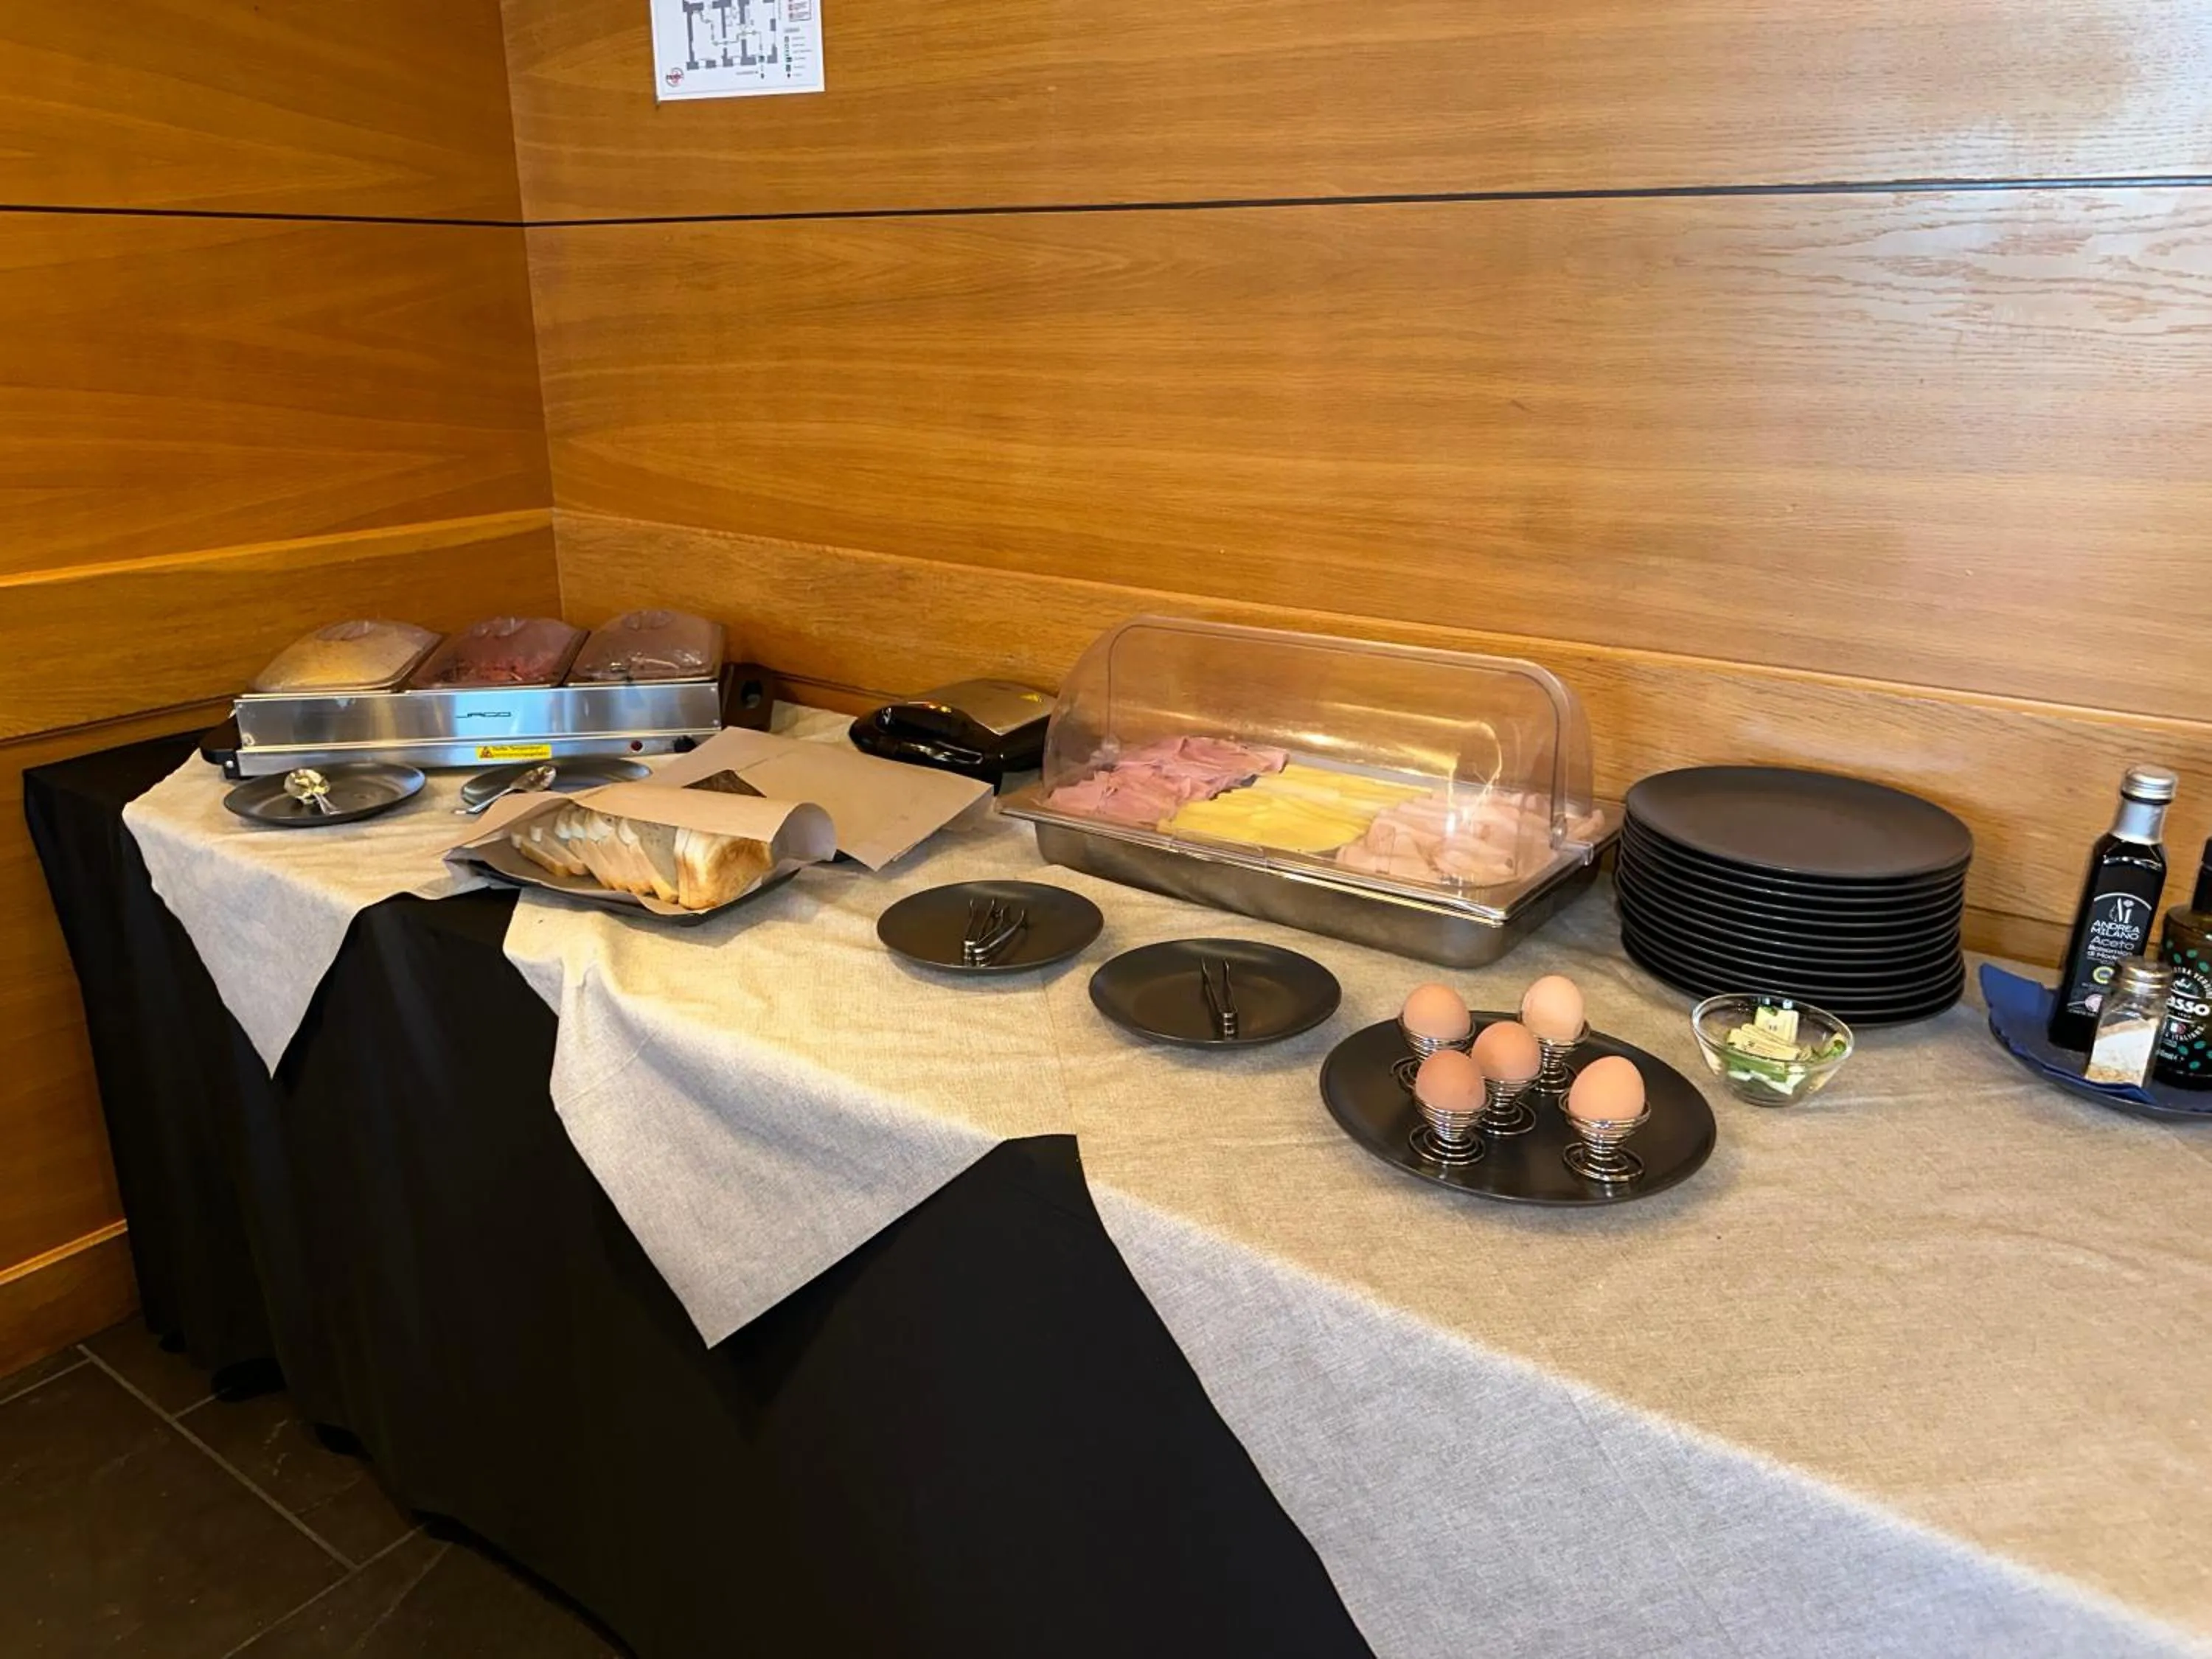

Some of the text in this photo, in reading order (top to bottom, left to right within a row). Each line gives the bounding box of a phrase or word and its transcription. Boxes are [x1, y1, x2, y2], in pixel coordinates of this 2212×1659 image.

[2090, 926, 2139, 940] MILANO
[2093, 919, 2140, 933] ANDREA
[2090, 936, 2135, 950] Aceto
[2096, 952, 2120, 961] Mode
[2166, 995, 2211, 1017] asso
